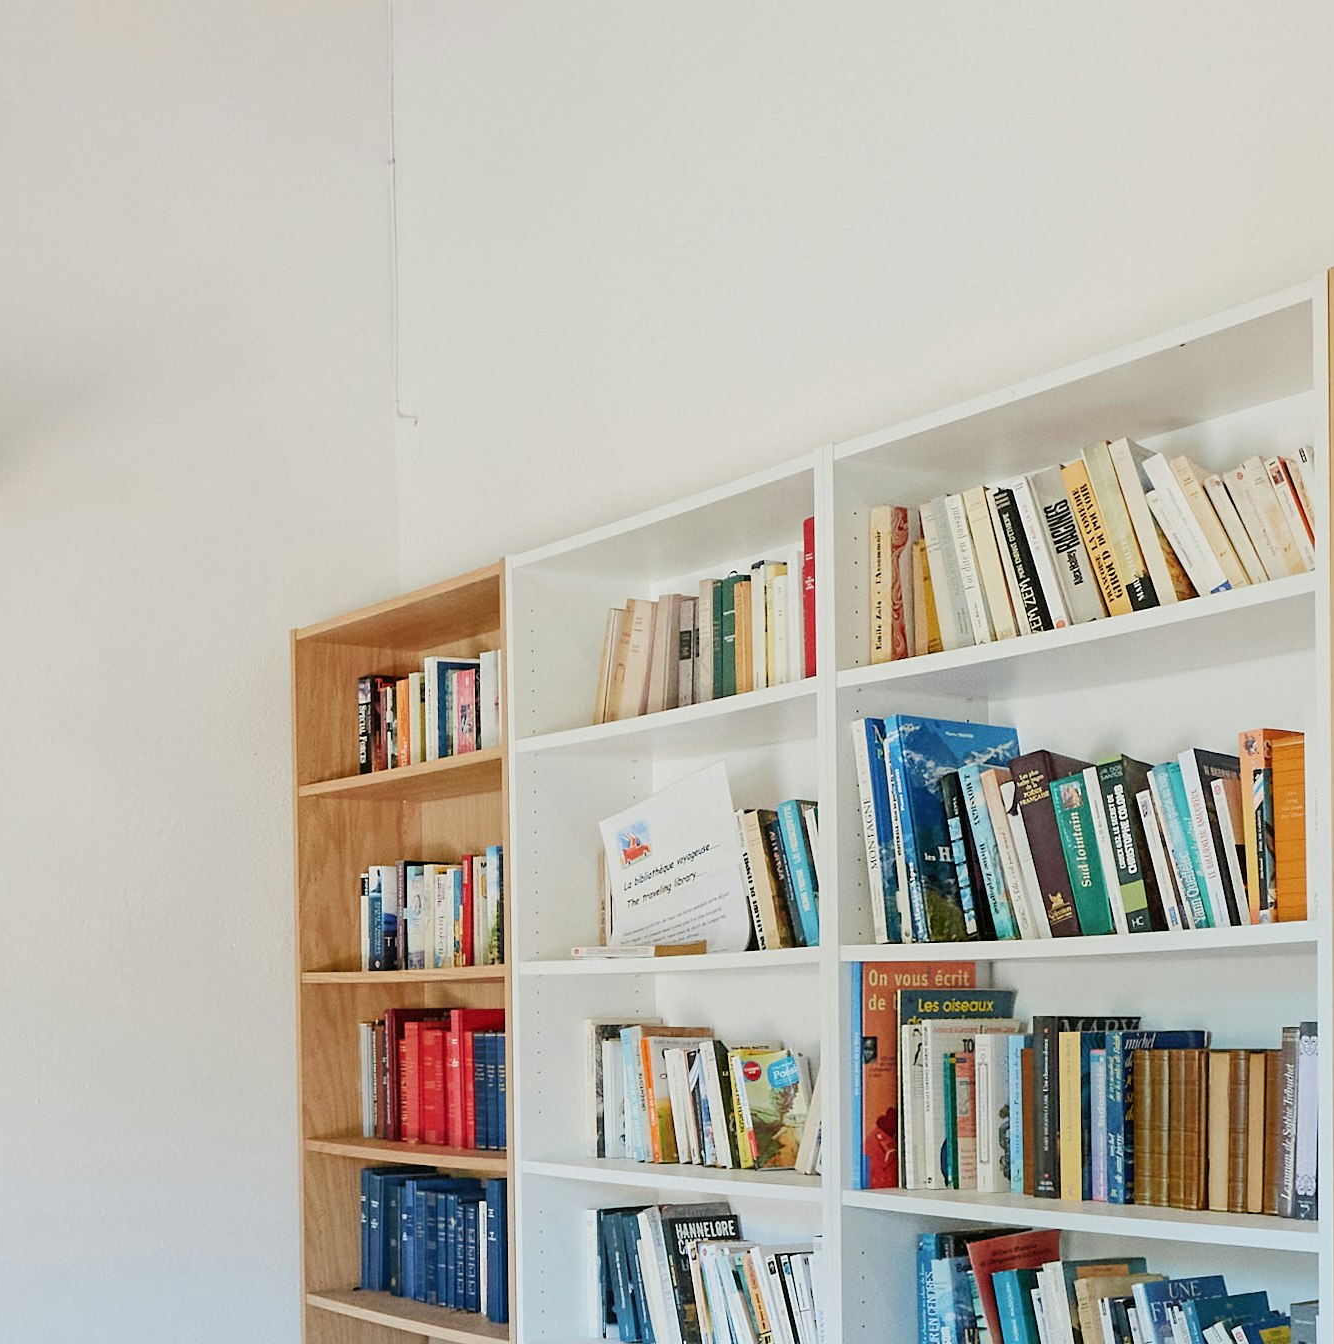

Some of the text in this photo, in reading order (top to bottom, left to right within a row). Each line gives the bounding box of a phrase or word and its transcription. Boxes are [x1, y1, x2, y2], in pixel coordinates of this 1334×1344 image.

[1043, 499, 1081, 554] RACINES
[1079, 483, 1106, 546] DU POUVOIR
[1065, 549, 1084, 585] Alex Haley
[1094, 554, 1115, 603] FRANÇOISE
[1103, 550, 1123, 599] GIROUD
[358, 704, 368, 763] SPECIAL FORCES
[863, 796, 879, 869] MONTAGNE
[1070, 811, 1092, 888] Sud lointain
[1115, 783, 1139, 874] CHRISTOPHE COLOMB
[624, 881, 631, 891] La
[635, 862, 674, 886] bibliothèque
[627, 898, 639, 908] The
[642, 883, 672, 902] traveling
[868, 969, 969, 987] On vous écrit
[868, 993, 885, 1011] de
[918, 999, 994, 1013] Les oiseaux
[1281, 1063, 1295, 1200] Le roman de Sophie Trébuchet
[675, 1220, 736, 1239] HANNELORE
[925, 1271, 938, 1316] CENDRES
[1168, 1280, 1201, 1297] UNE
[928, 1318, 939, 1332] EN
